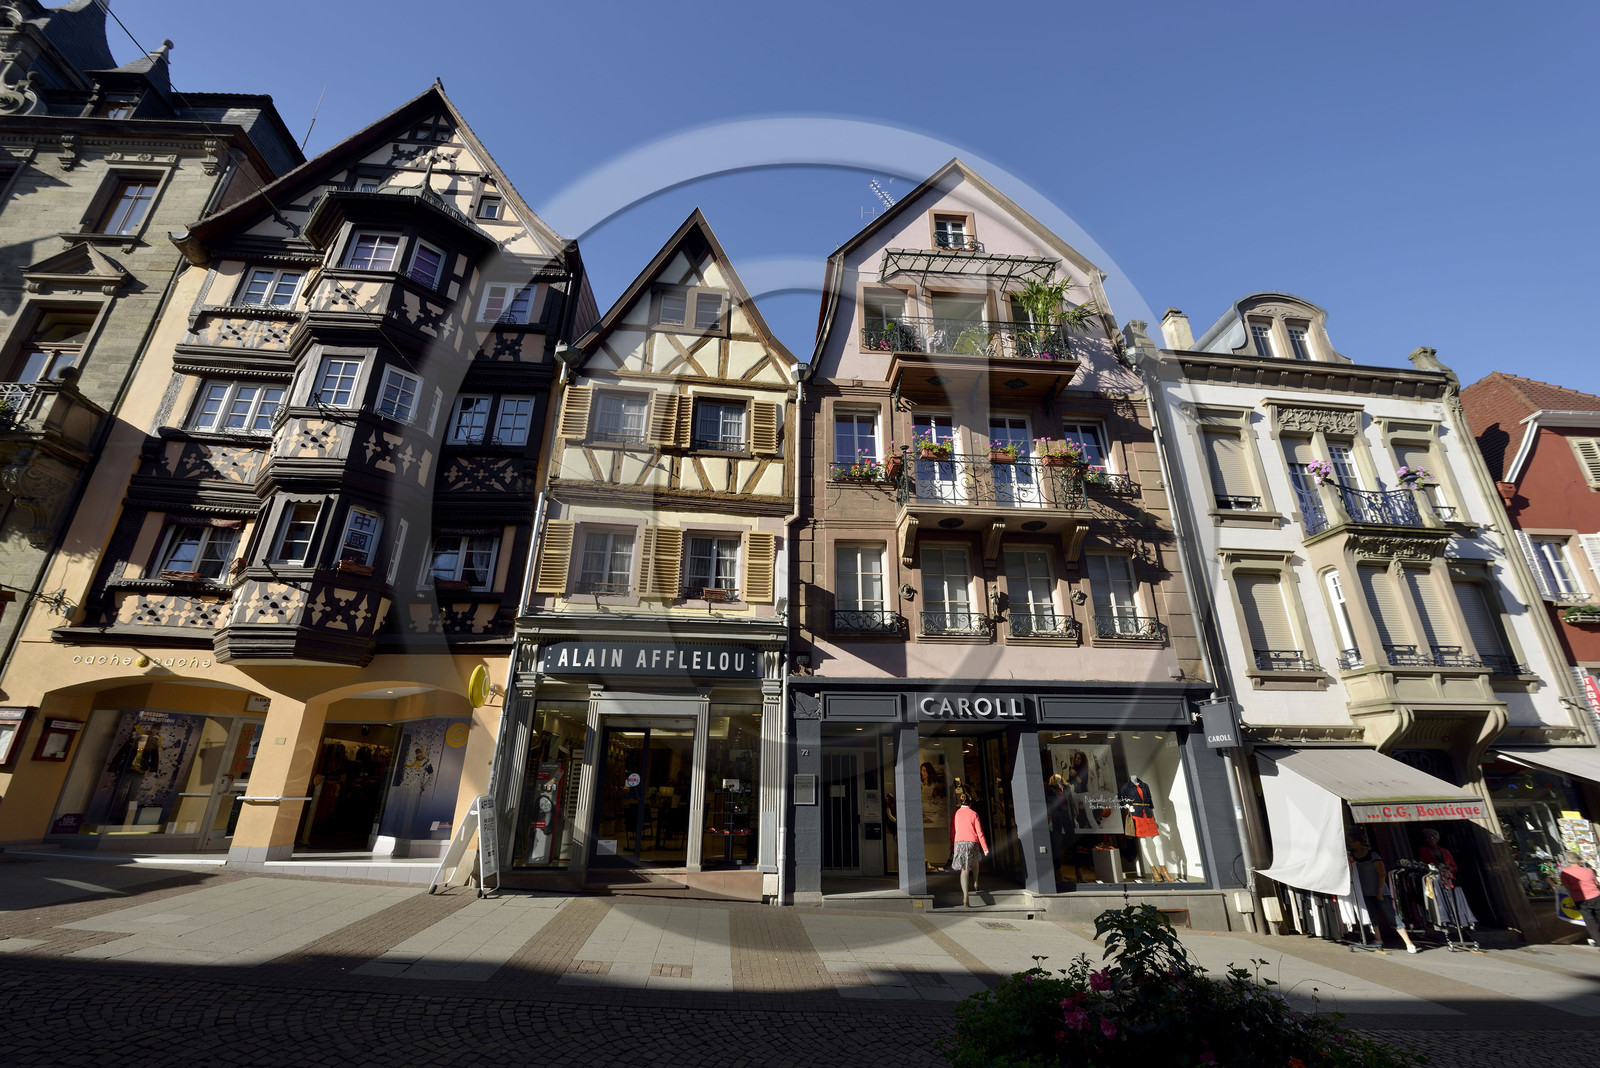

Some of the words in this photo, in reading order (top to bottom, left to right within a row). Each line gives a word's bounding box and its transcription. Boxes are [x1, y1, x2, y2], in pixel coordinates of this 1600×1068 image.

[73, 654, 133, 666] cache
[152, 656, 212, 669] cache
[557, 648, 623, 668] ALAIN
[636, 649, 744, 672] AFFLELOU
[920, 697, 1024, 716] CAROLL
[1208, 734, 1232, 743] CAROLL
[1416, 804, 1481, 818] Boutique
